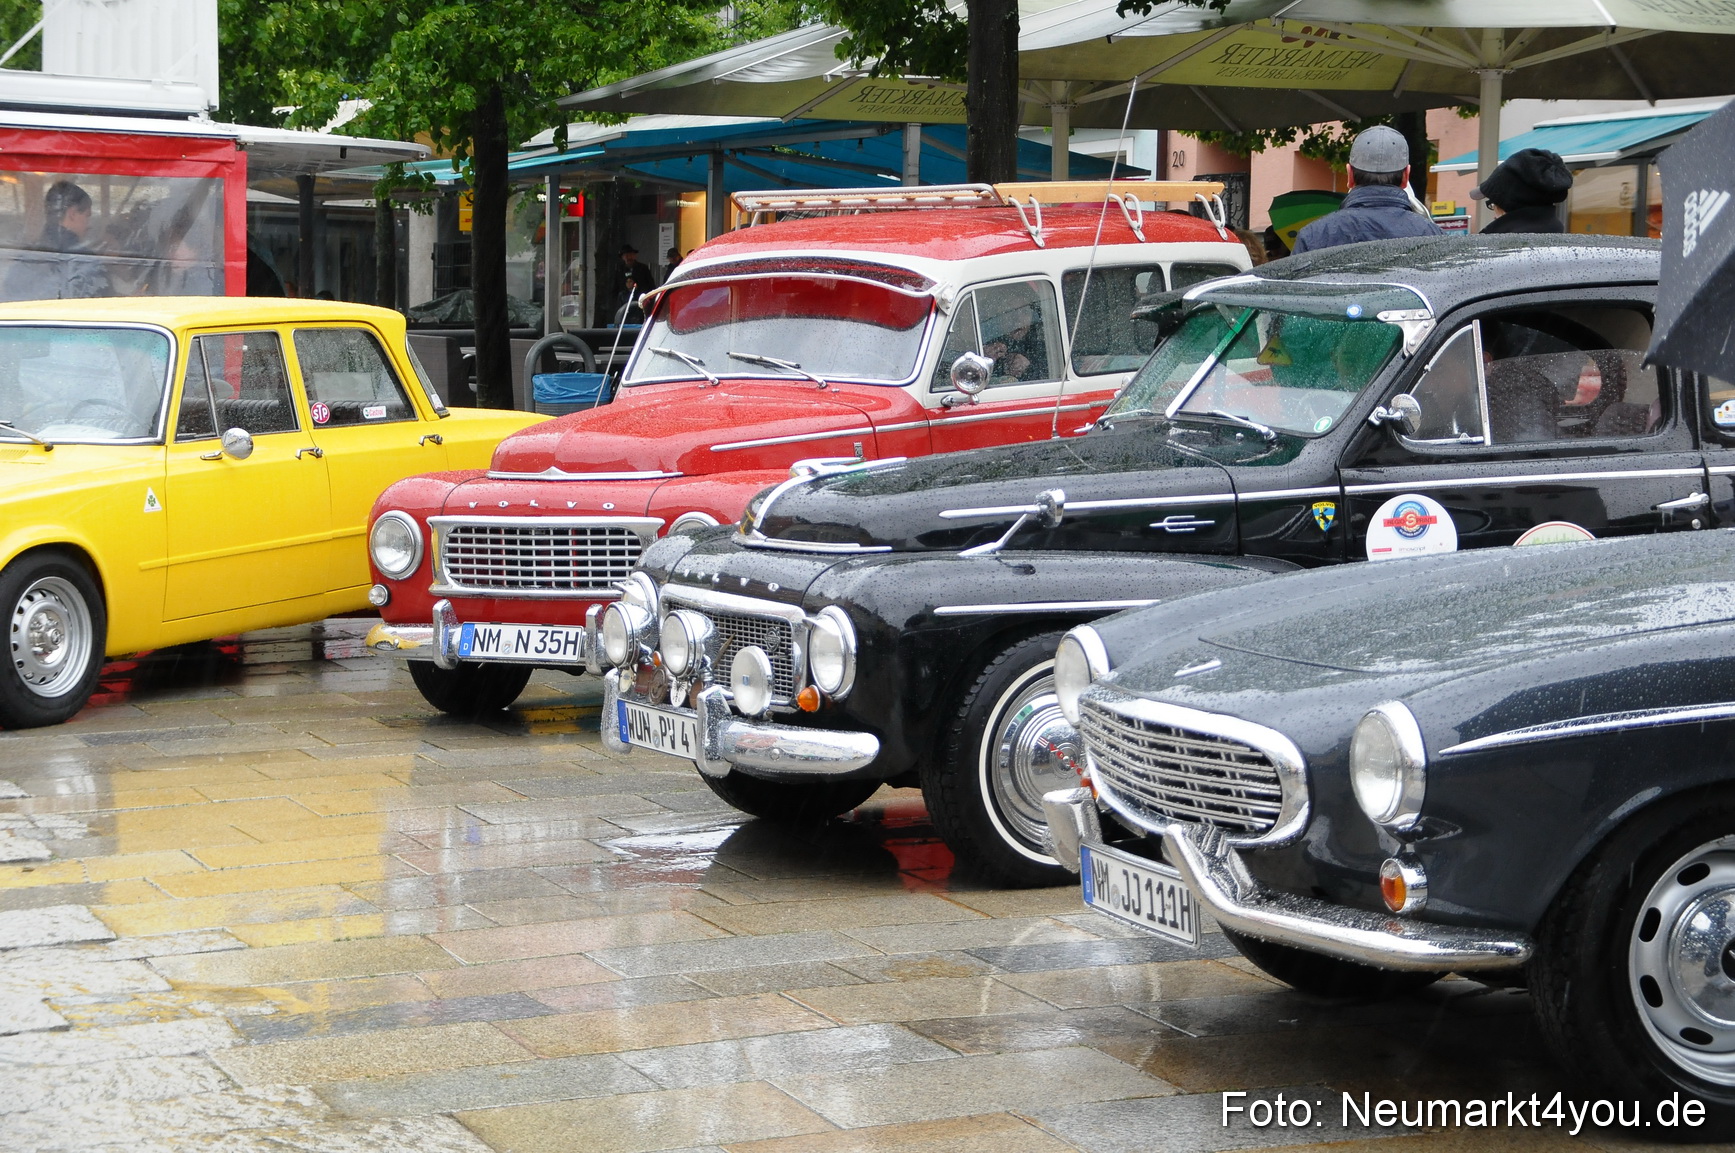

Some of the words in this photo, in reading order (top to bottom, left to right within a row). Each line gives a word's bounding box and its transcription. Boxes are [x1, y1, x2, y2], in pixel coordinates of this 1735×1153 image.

[1172, 150, 1185, 168] 20
[1683, 191, 1699, 258] adidas
[312, 404, 328, 420] STP
[468, 500, 615, 510] VOLVO
[683, 568, 780, 592] VOLVO
[463, 642, 469, 651] D
[472, 628, 502, 652] NM
[515, 629, 531, 654] N
[534, 630, 580, 656] 35H
[1091, 856, 1111, 904] NM
